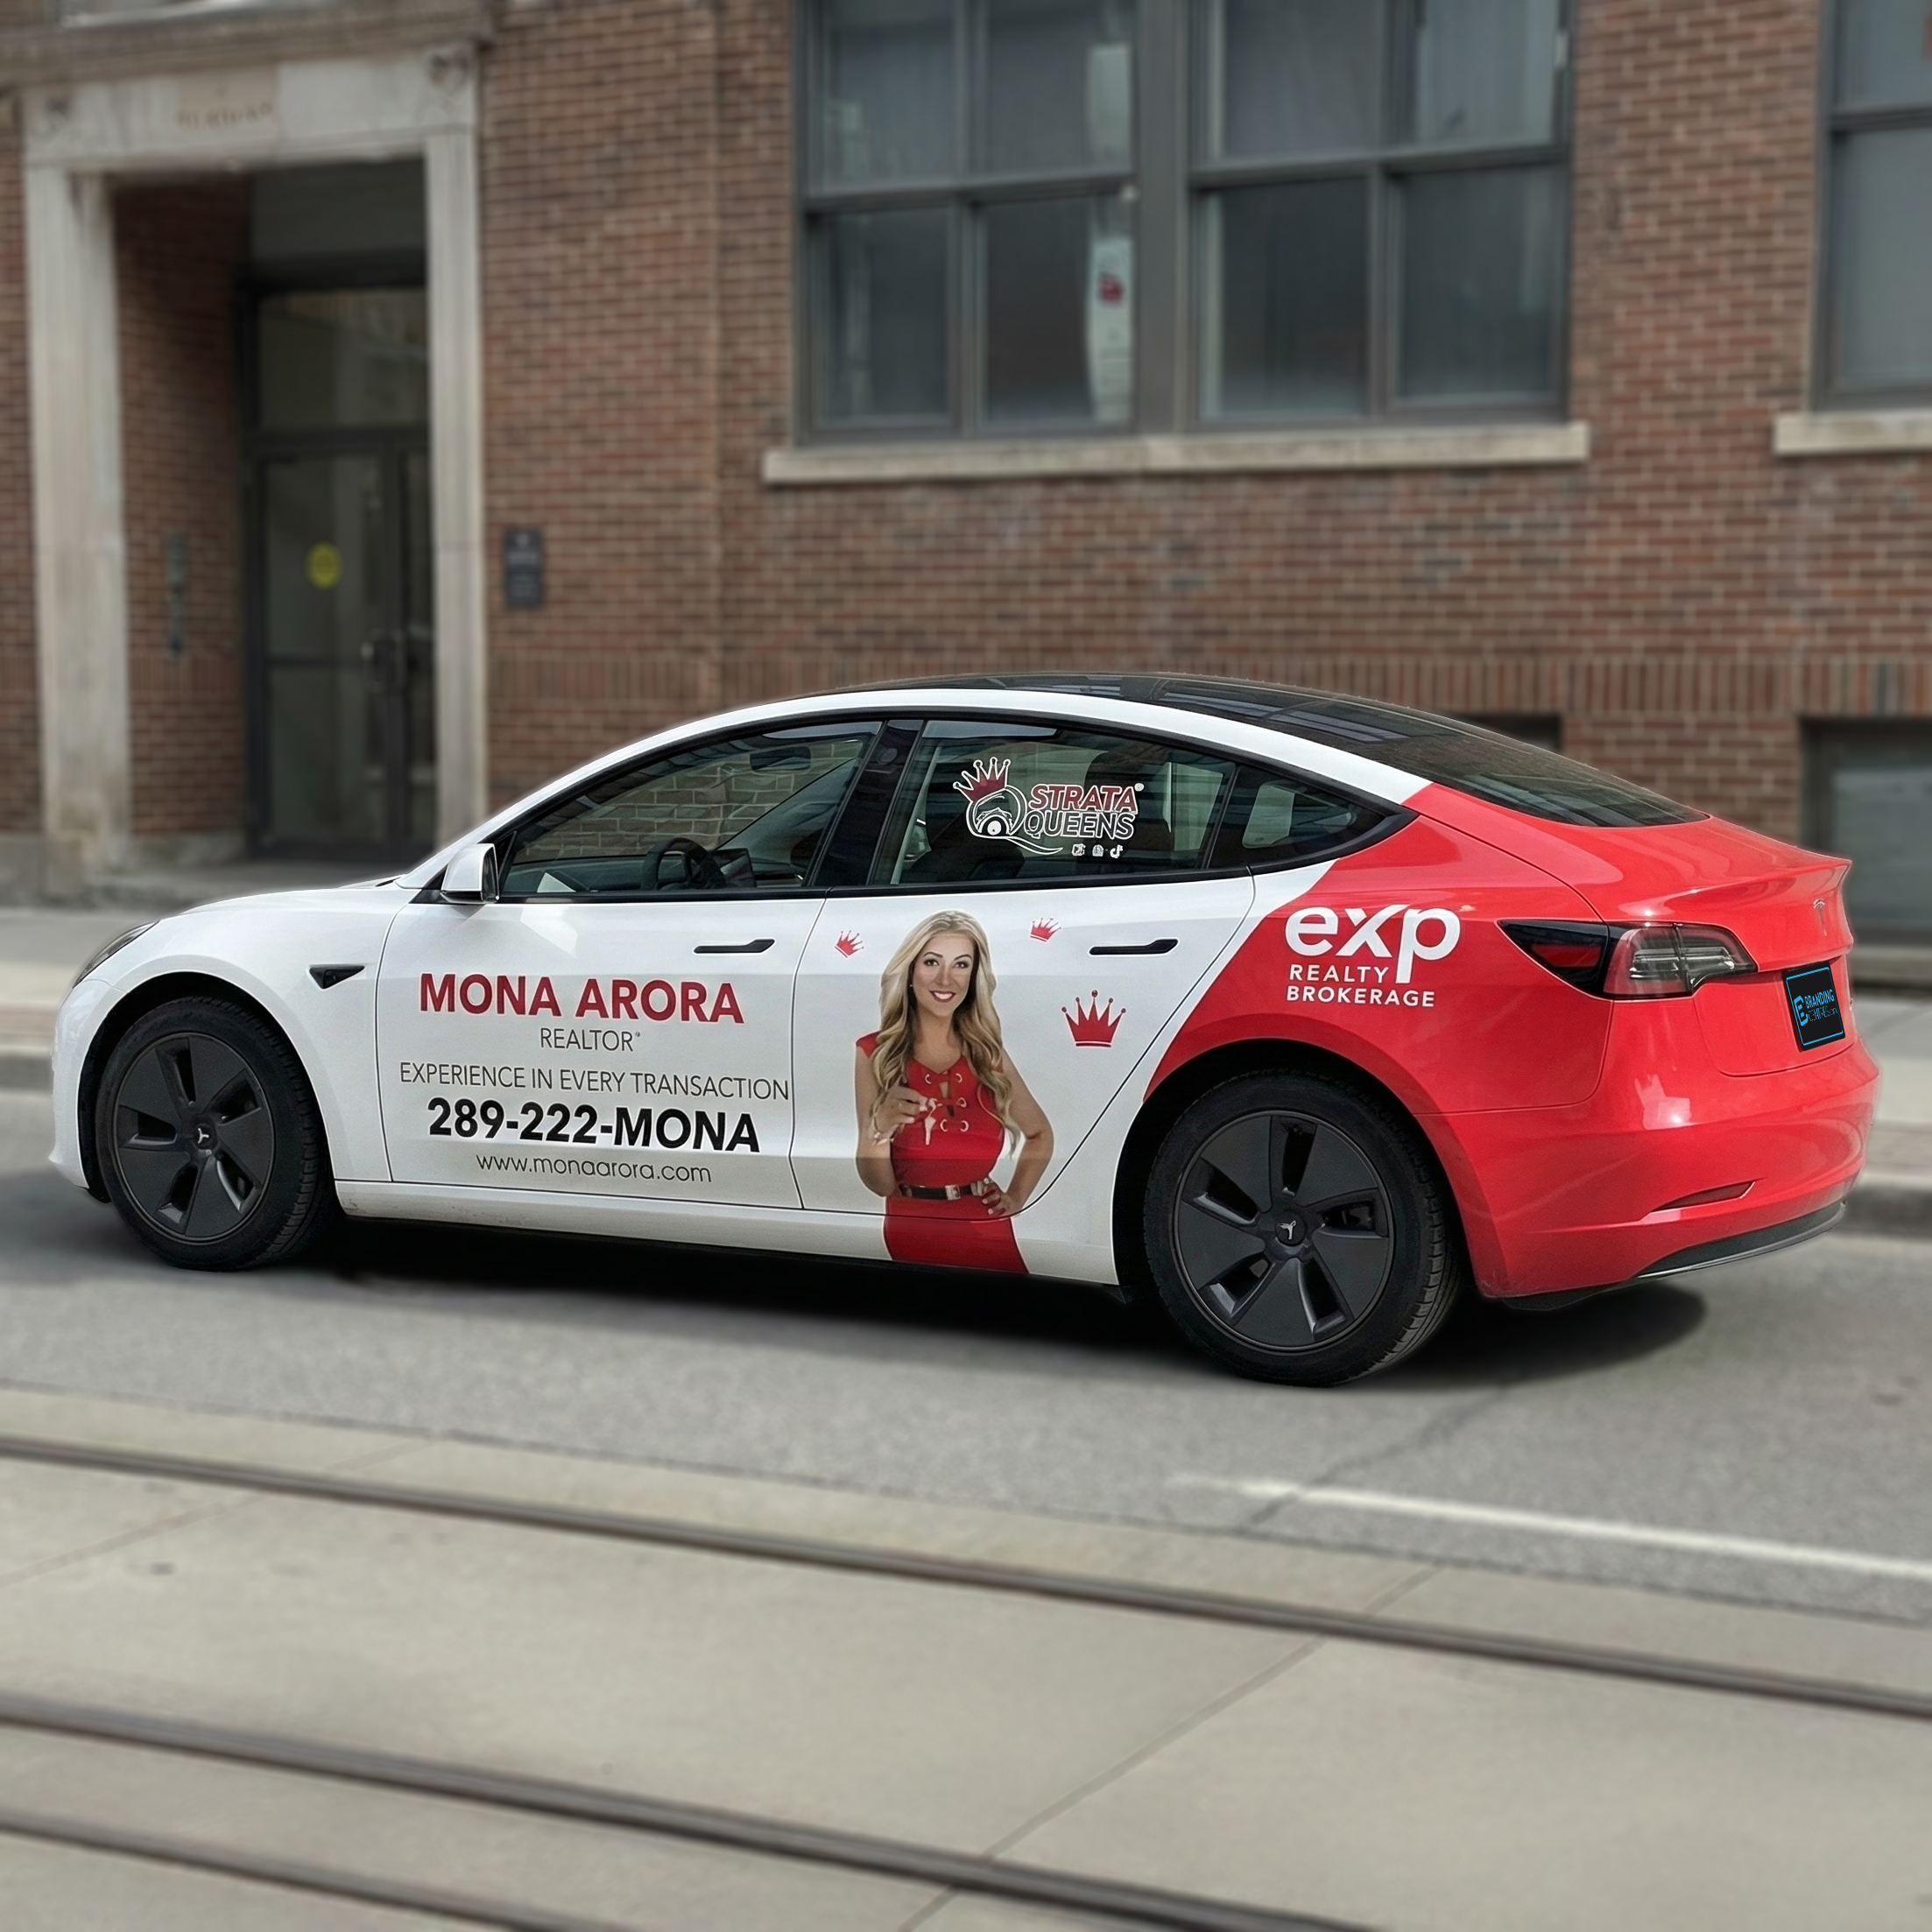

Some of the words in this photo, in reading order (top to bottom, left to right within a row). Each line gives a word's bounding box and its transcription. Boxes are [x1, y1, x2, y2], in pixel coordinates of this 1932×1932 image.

[1028, 783, 1139, 814] STRATA
[1023, 810, 1136, 840] QUEENS
[1284, 903, 1462, 984] exp
[1289, 963, 1390, 984] REALTY
[420, 973, 562, 1017] MONA
[575, 978, 744, 1024] ARORA
[1287, 985, 1435, 1008] BROKERAGE
[1804, 989, 1835, 1010] BRANDING
[399, 1061, 525, 1088] EXPERIENCE
[532, 1068, 553, 1089] IN
[560, 1069, 625, 1092] EVERY
[631, 1072, 789, 1101] TRANSACTION
[427, 1096, 760, 1153] 289-222-MONA
[476, 1154, 712, 1182] www.monaarora.com
